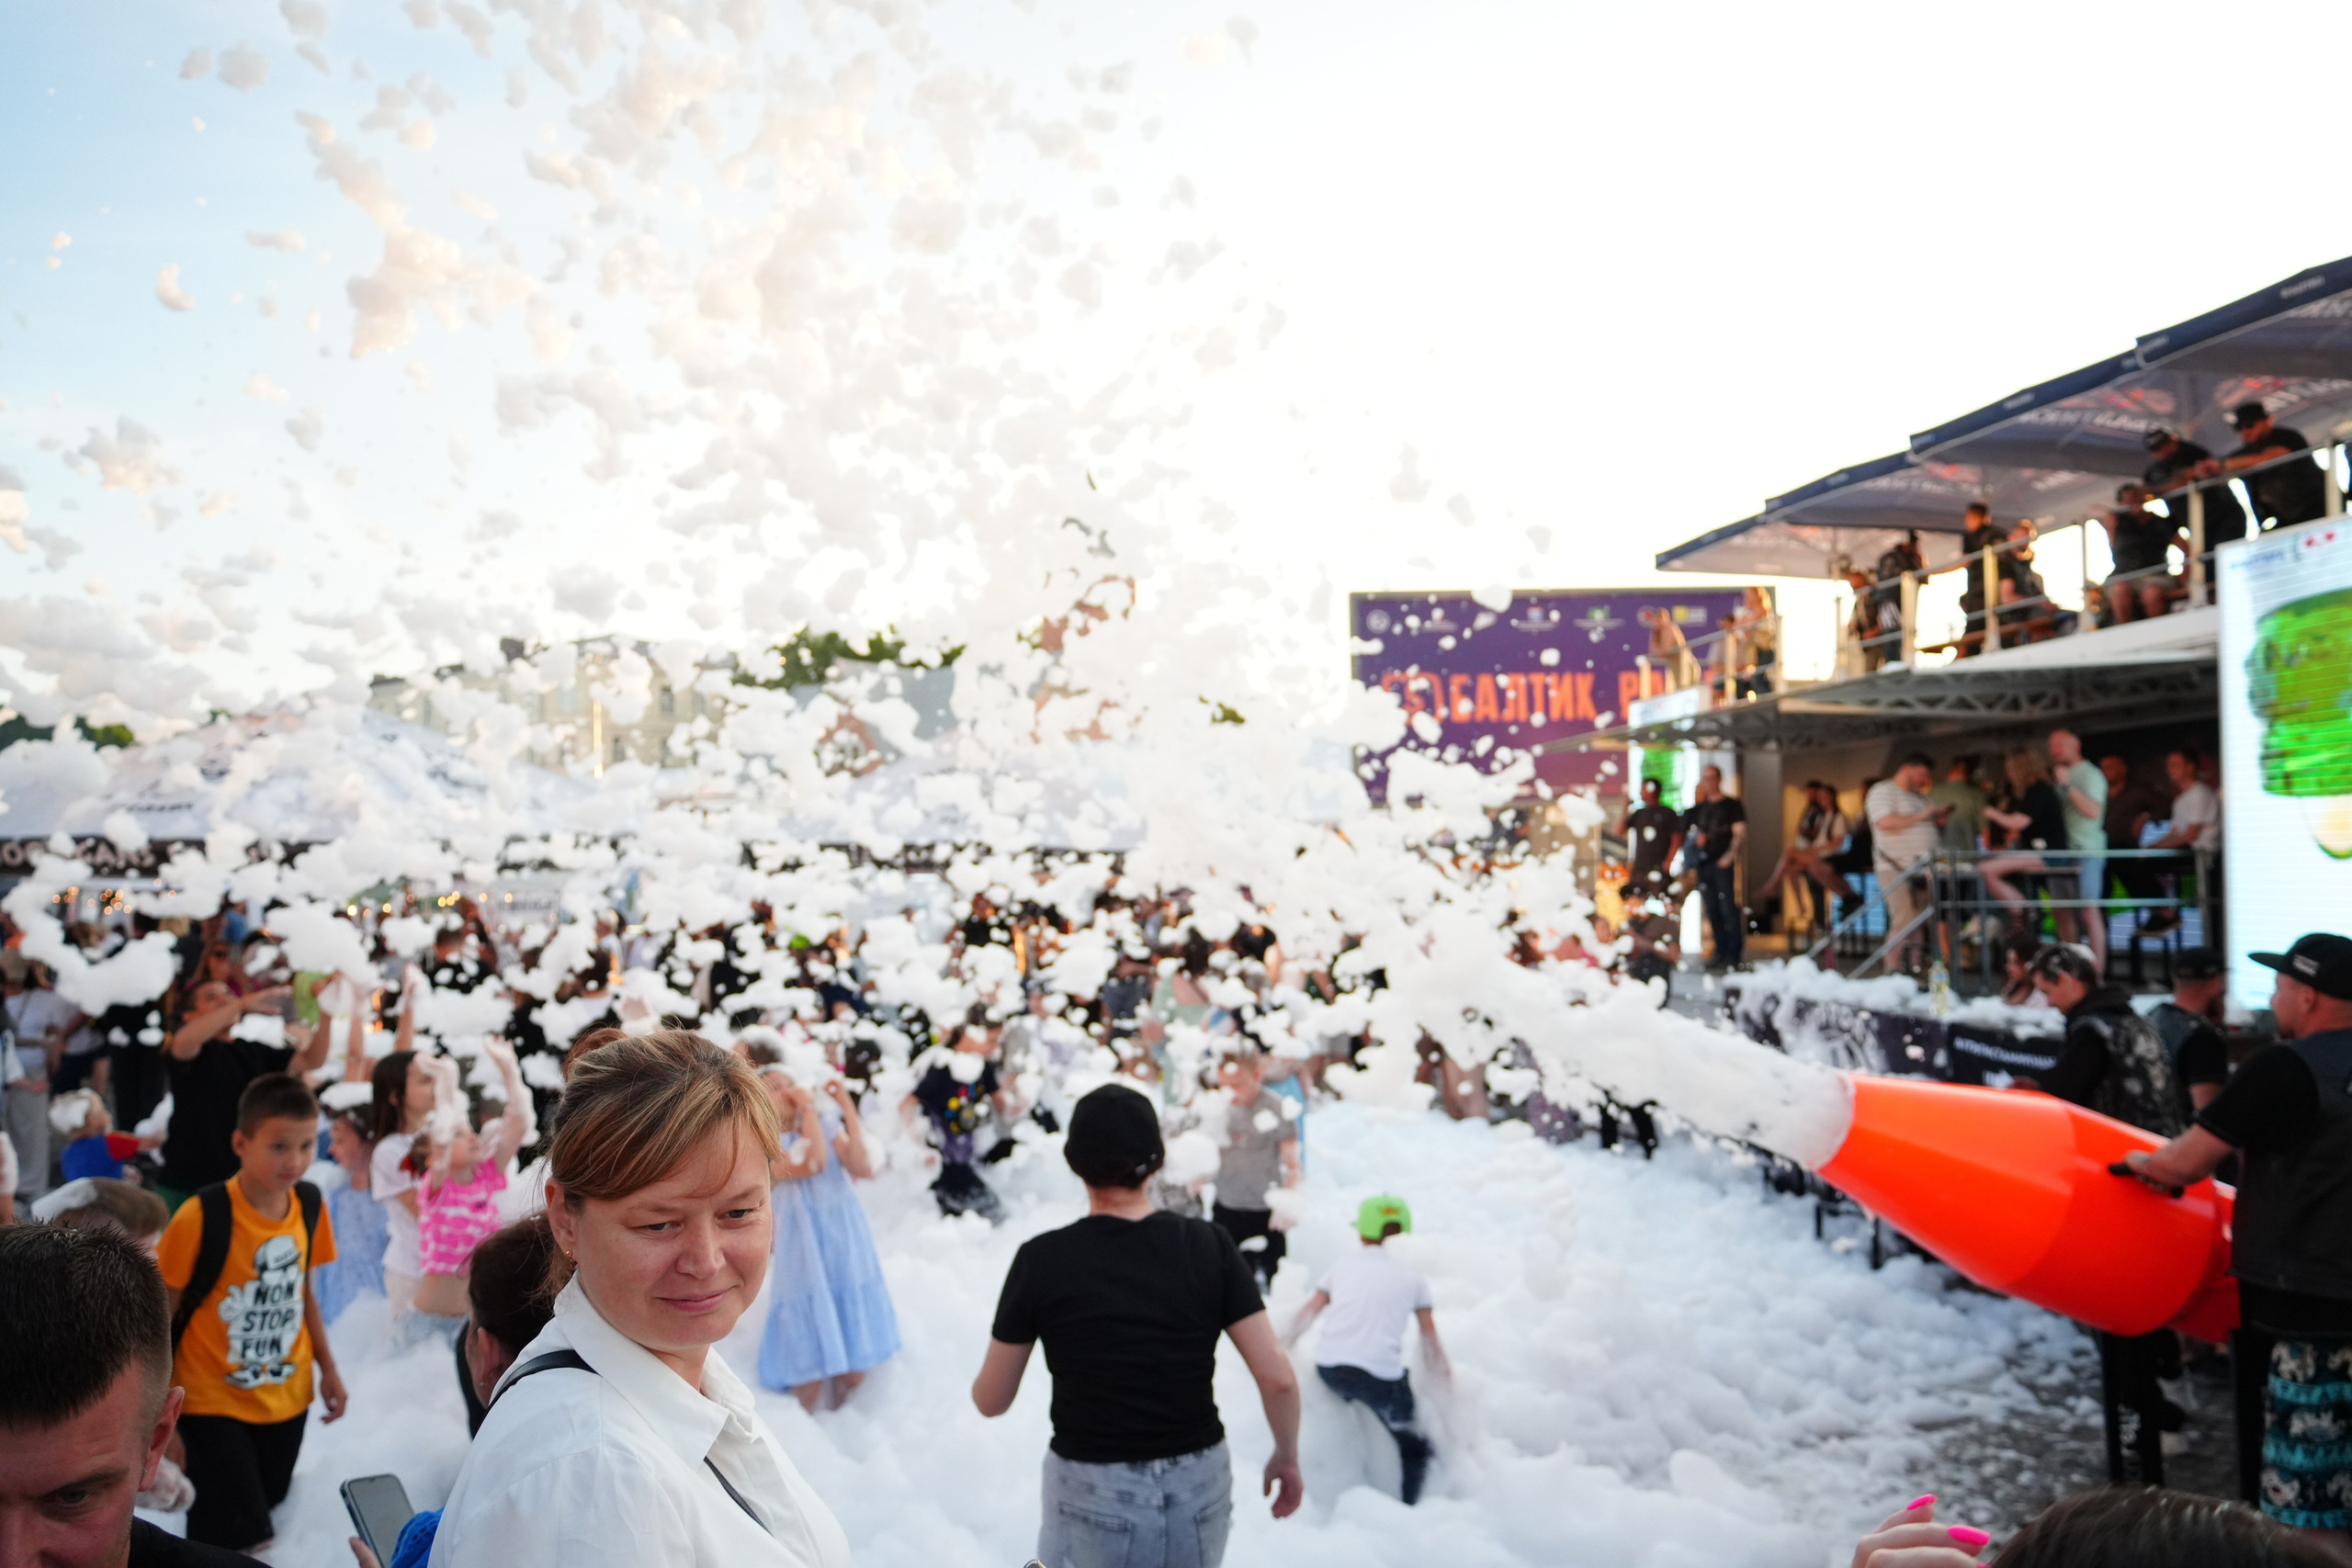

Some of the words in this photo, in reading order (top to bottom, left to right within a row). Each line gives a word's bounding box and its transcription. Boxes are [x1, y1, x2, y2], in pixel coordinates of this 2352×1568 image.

[254, 1281, 294, 1305] NON
[243, 1308, 294, 1333] STOP
[242, 1337, 281, 1359] FUN
